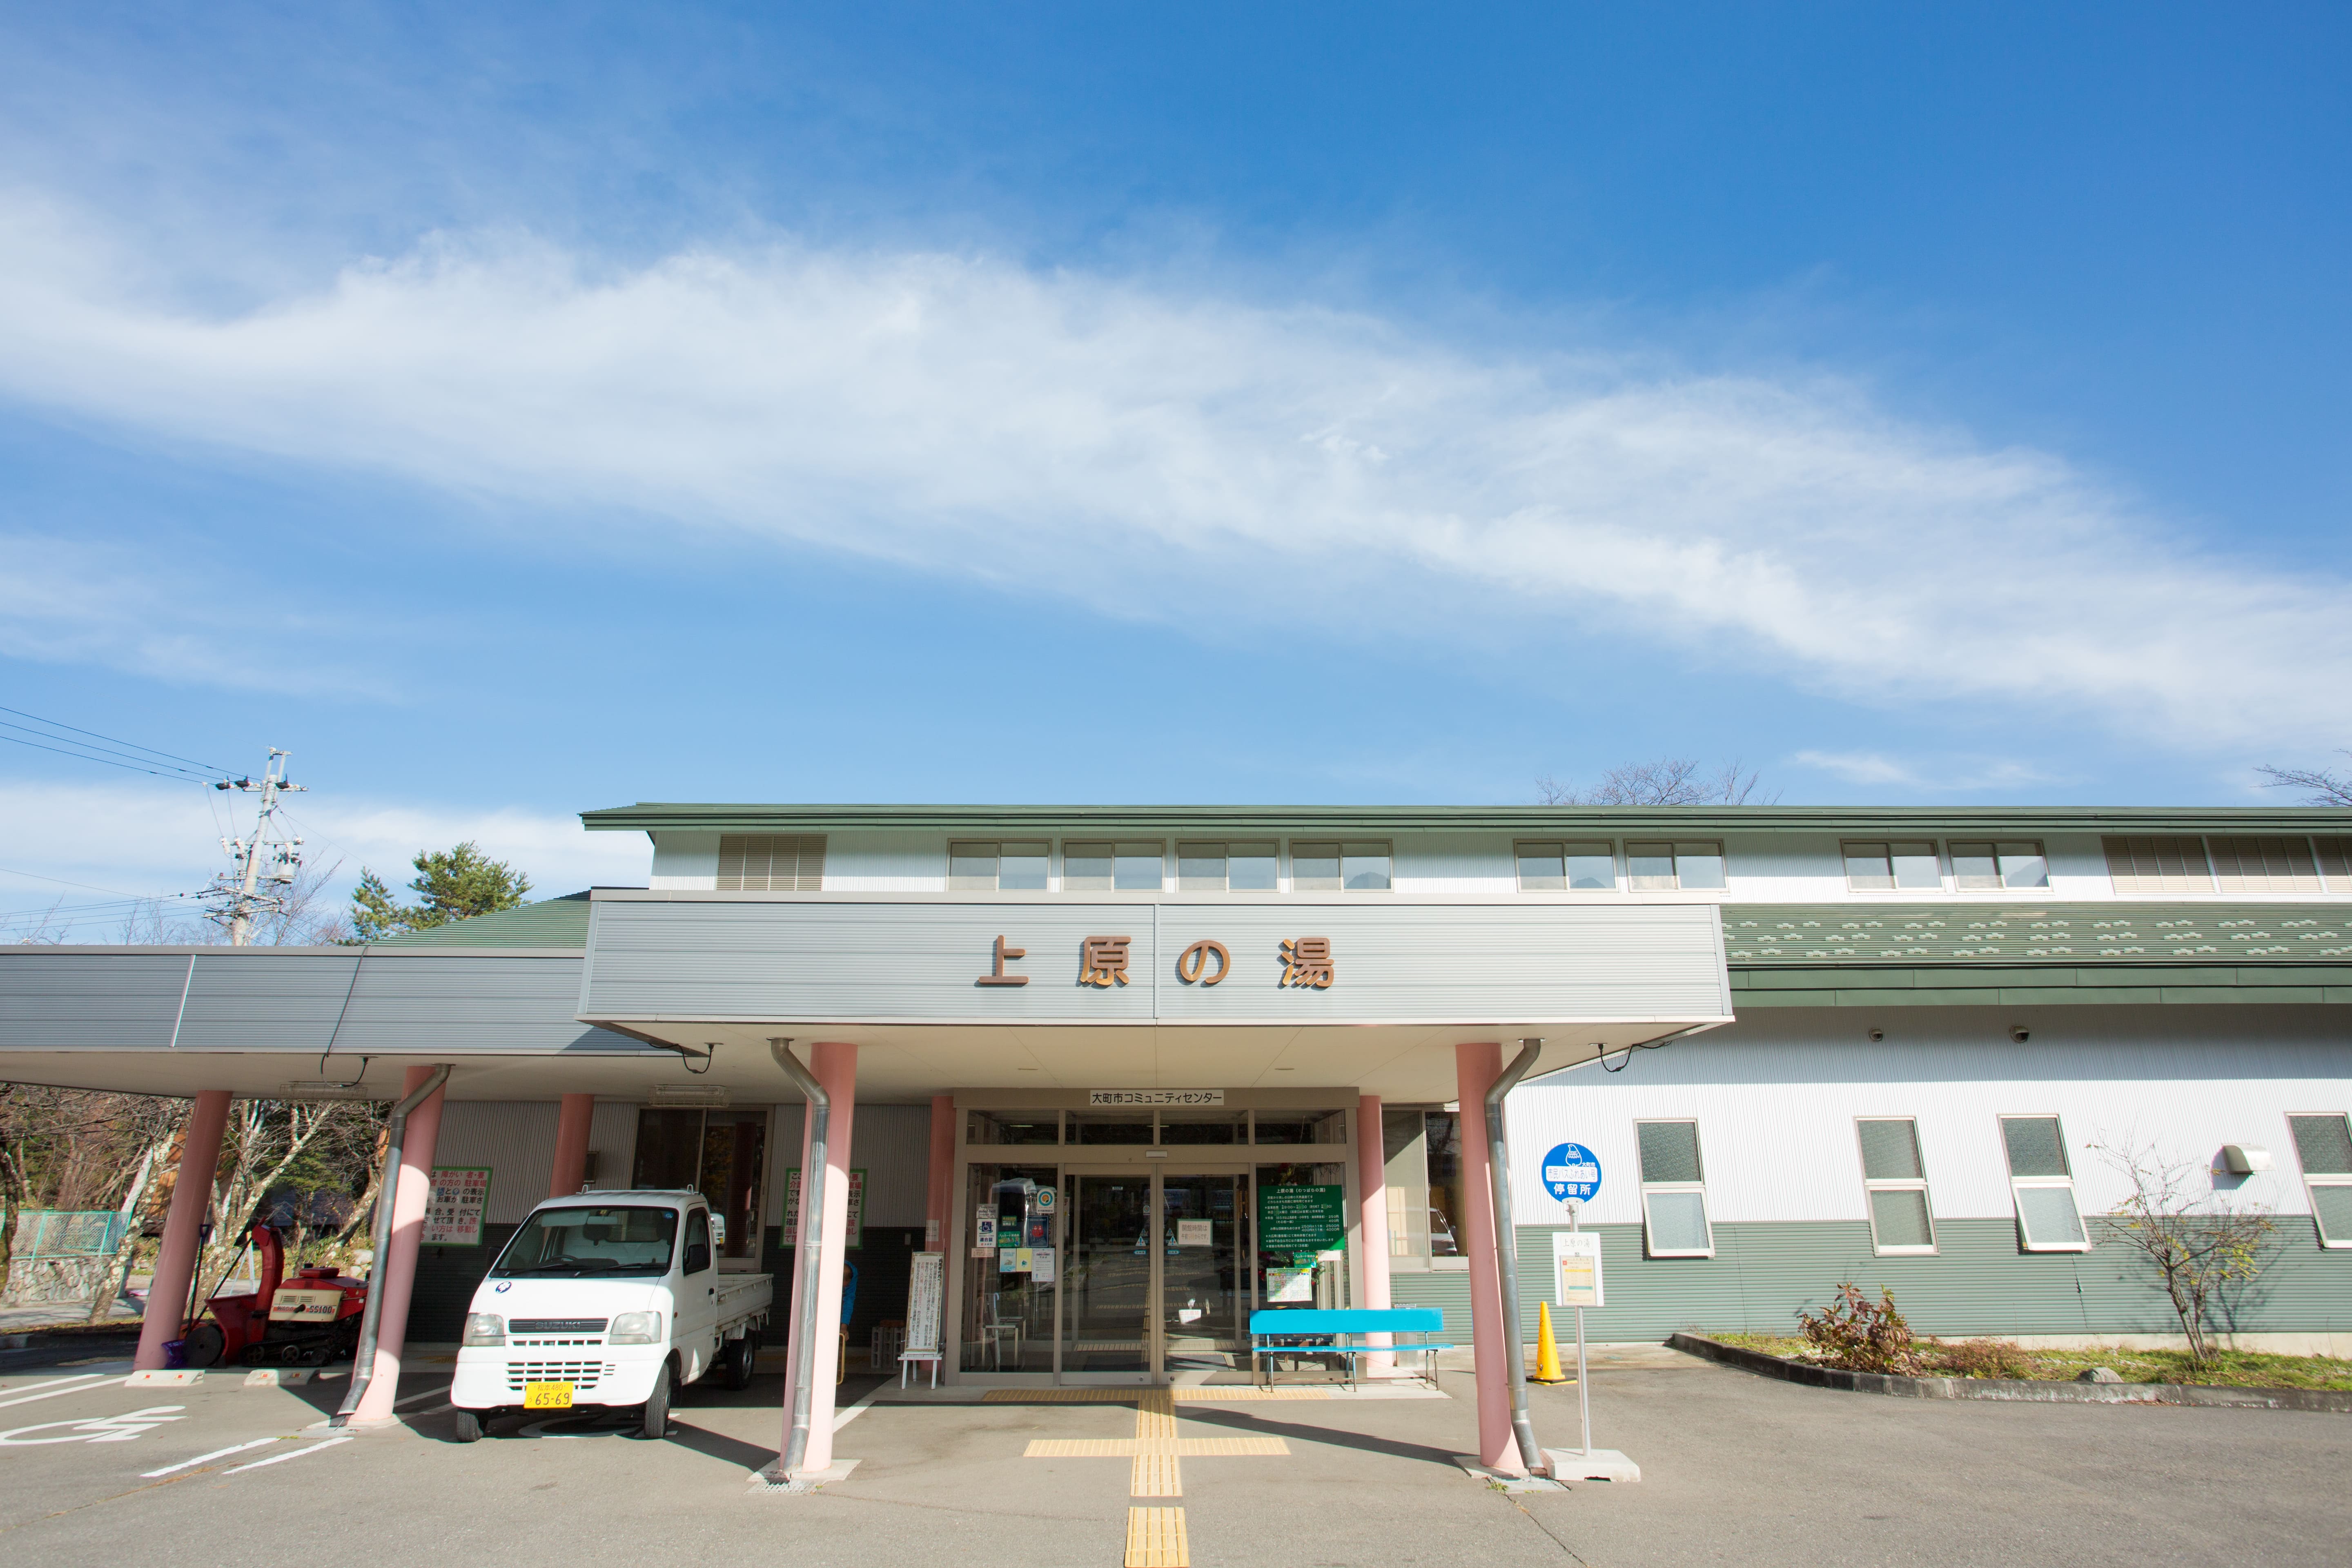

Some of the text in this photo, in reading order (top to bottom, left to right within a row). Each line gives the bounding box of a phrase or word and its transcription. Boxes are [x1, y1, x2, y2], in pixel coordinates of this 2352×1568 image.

[978, 935, 1335, 988] 上原の湯
[1091, 1091, 1223, 1106] 大町市コミュニティセンター
[1548, 1168, 1596, 1180] 市民バスふれあい号
[1553, 1183, 1591, 1195] 停留所
[1563, 1238, 1590, 1247] 上原の湯
[535, 1321, 581, 1329] SUZUKI
[535, 1392, 570, 1405] 65-69
